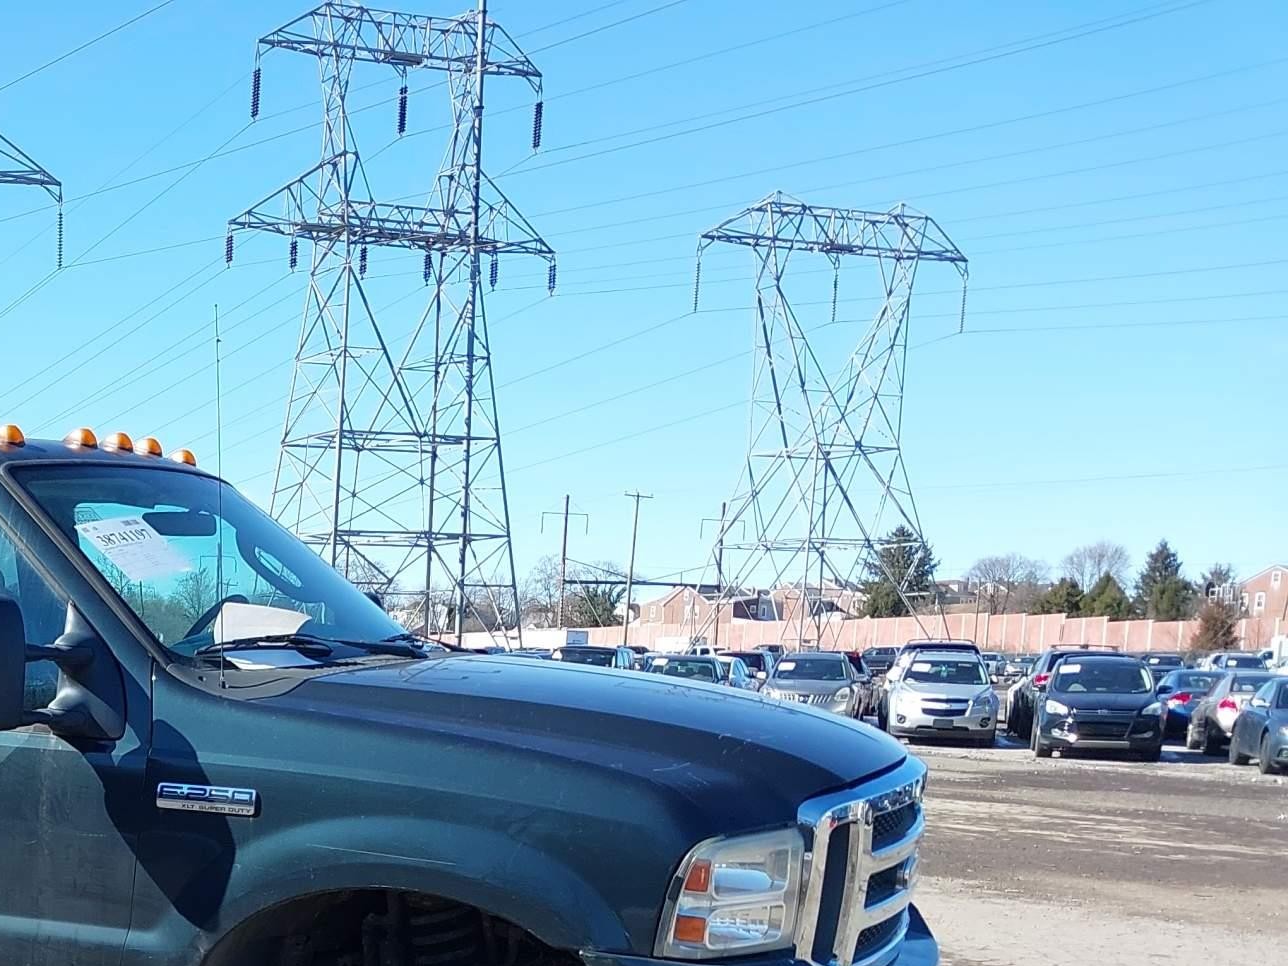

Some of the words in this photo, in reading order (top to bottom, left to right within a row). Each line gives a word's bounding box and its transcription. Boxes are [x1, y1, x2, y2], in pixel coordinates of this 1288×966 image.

[96, 528, 153, 547] 38741197
[198, 804, 226, 812] SUPER
[228, 806, 252, 814] DUTY
